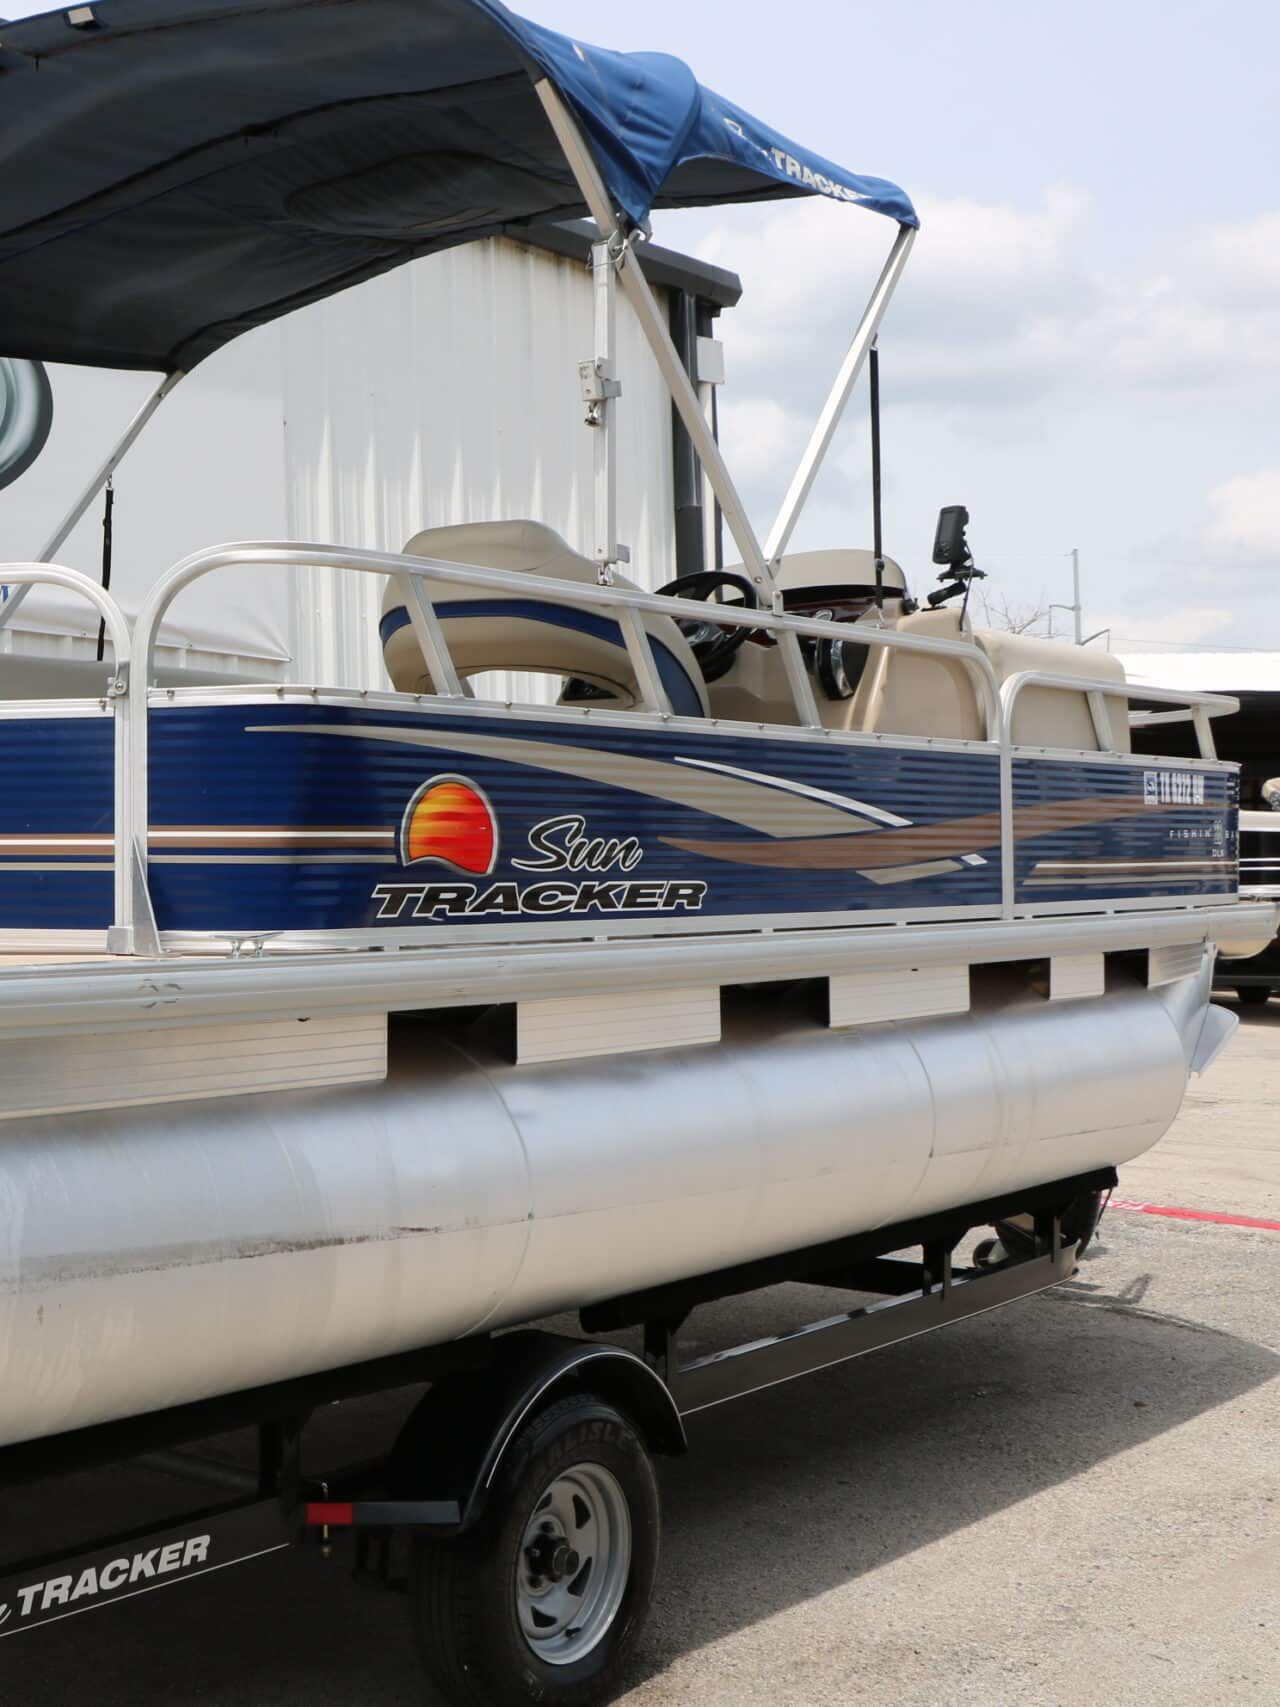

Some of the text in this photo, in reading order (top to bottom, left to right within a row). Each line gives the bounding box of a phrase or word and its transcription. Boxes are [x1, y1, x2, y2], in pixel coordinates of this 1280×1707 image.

[511, 814, 644, 872] Sun
[371, 881, 709, 921] TRACKER
[17, 1534, 211, 1617] TRACKER
